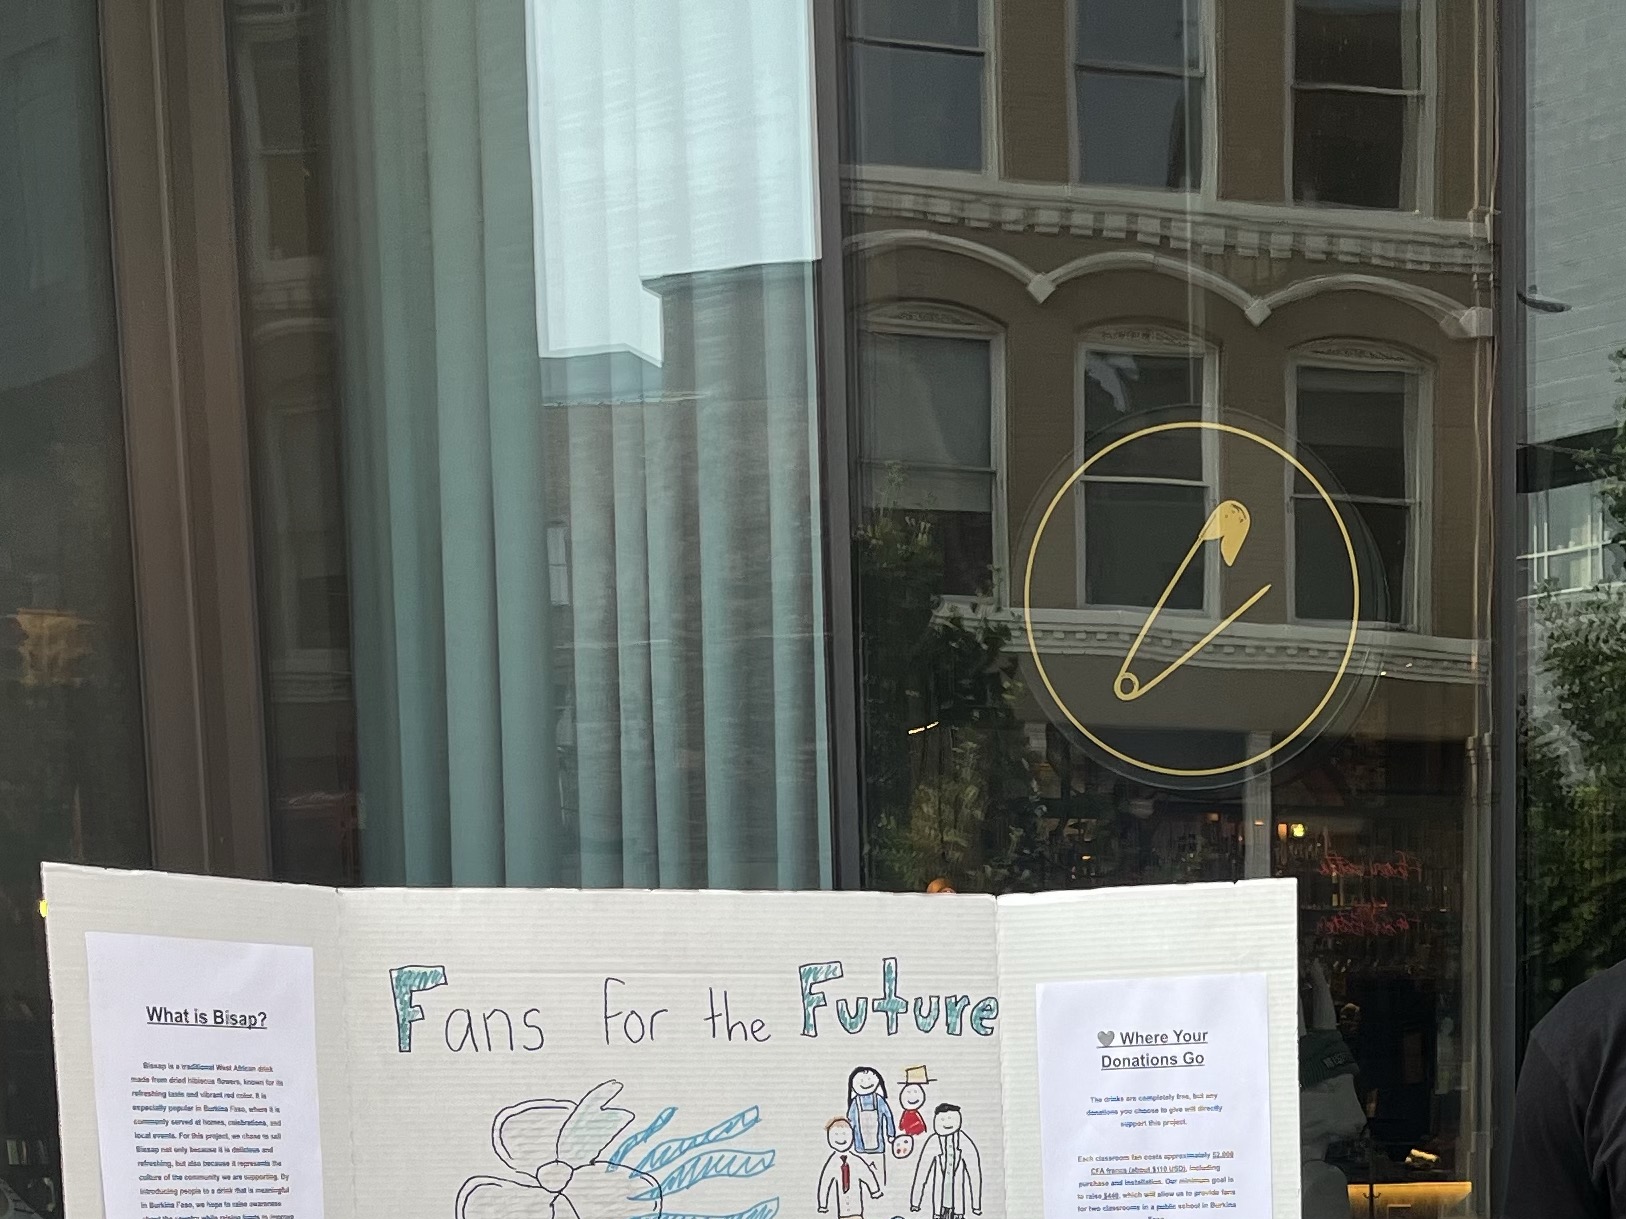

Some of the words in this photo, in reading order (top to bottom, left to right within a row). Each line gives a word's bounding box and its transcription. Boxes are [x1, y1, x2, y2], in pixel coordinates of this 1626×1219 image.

[389, 965, 545, 1053] Fans
[704, 987, 772, 1042] the
[799, 957, 999, 1037] Future
[146, 1006, 190, 1023] What
[194, 1008, 208, 1024] is
[213, 1009, 268, 1029] Bisap?
[1120, 1029, 1168, 1046] Where
[1172, 1028, 1209, 1045] Your
[1101, 1051, 1177, 1069] Donations
[1183, 1050, 1205, 1067] Go
